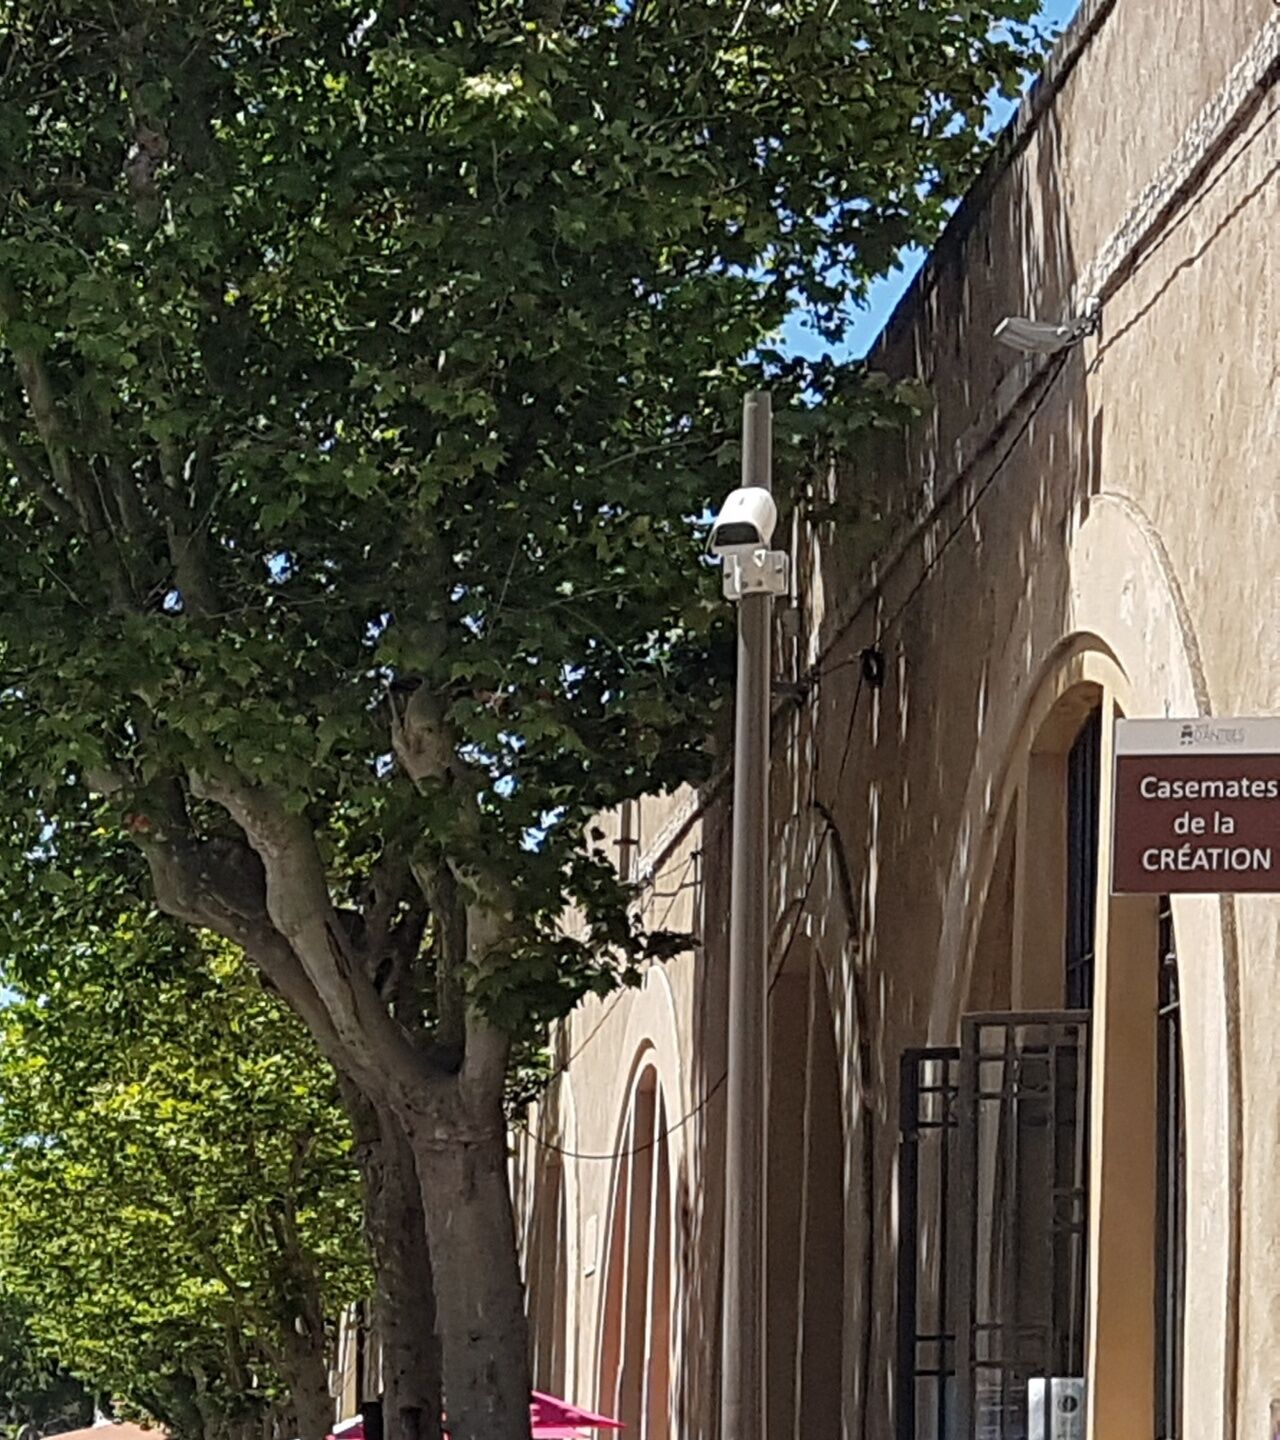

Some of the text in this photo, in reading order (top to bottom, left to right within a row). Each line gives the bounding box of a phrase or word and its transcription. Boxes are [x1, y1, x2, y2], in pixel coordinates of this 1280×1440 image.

[1140, 776, 1279, 798] Casemates
[1173, 811, 1235, 834] de la
[1142, 842, 1272, 870] CRÉATION
